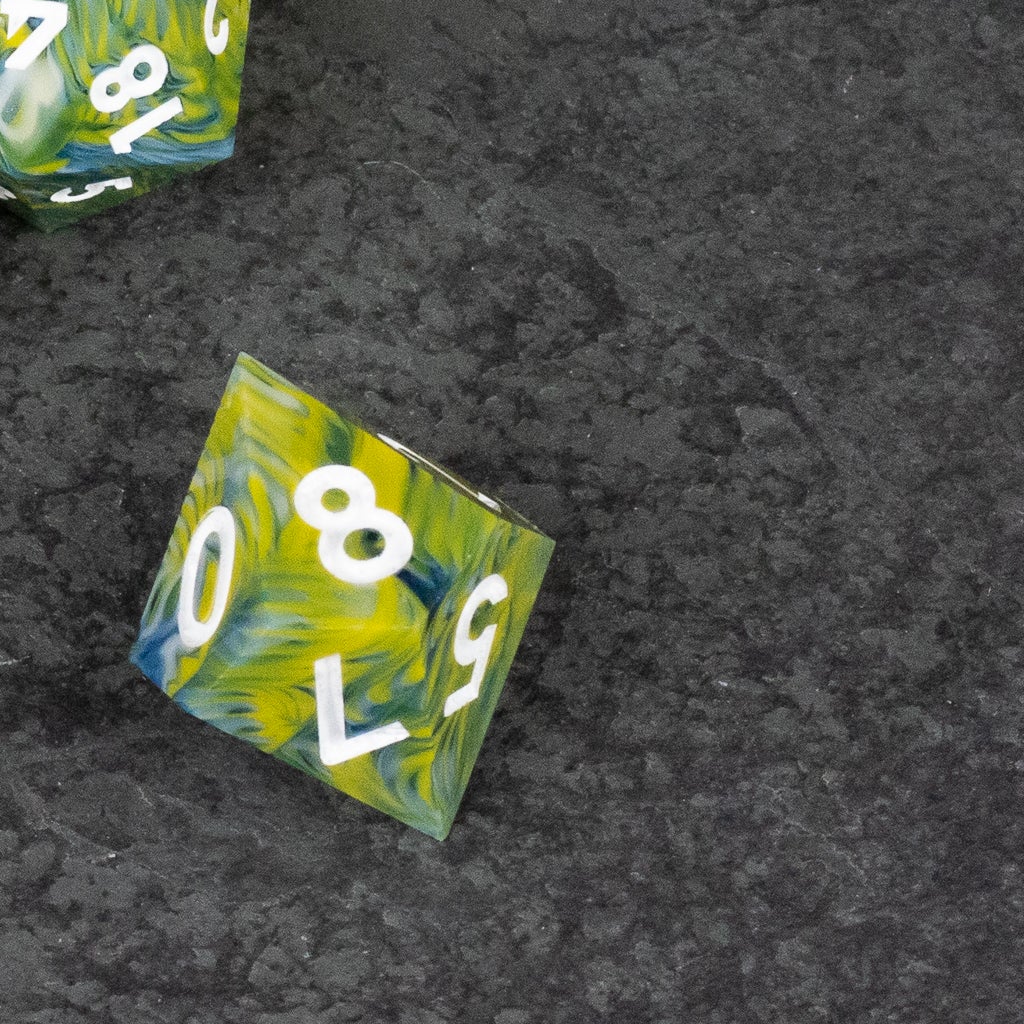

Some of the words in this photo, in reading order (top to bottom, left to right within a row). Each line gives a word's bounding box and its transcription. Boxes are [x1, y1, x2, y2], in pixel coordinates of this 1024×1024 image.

[89, 43, 183, 155] 18
[50, 176, 133, 203] 5
[178, 506, 235, 648] 0
[294, 465, 414, 584] 8
[444, 574, 508, 717] 5
[314, 653, 410, 766] 7
